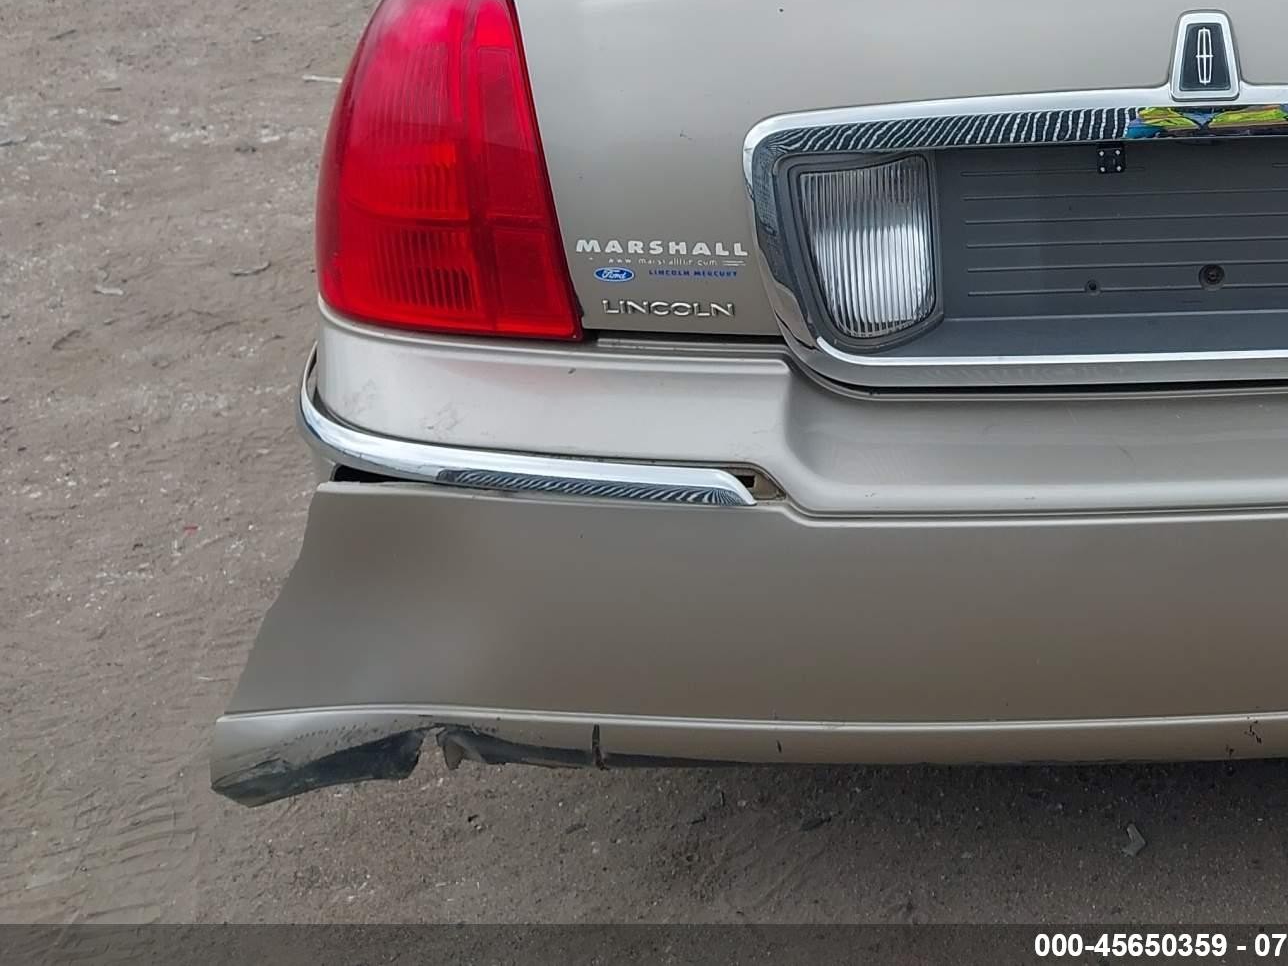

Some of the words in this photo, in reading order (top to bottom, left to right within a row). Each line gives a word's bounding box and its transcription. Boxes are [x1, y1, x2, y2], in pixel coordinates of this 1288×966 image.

[575, 239, 749, 256] MARSHALL
[648, 268, 690, 277] LINCOLN
[693, 269, 737, 278] MERCURY
[602, 299, 736, 317] LINCOLN
